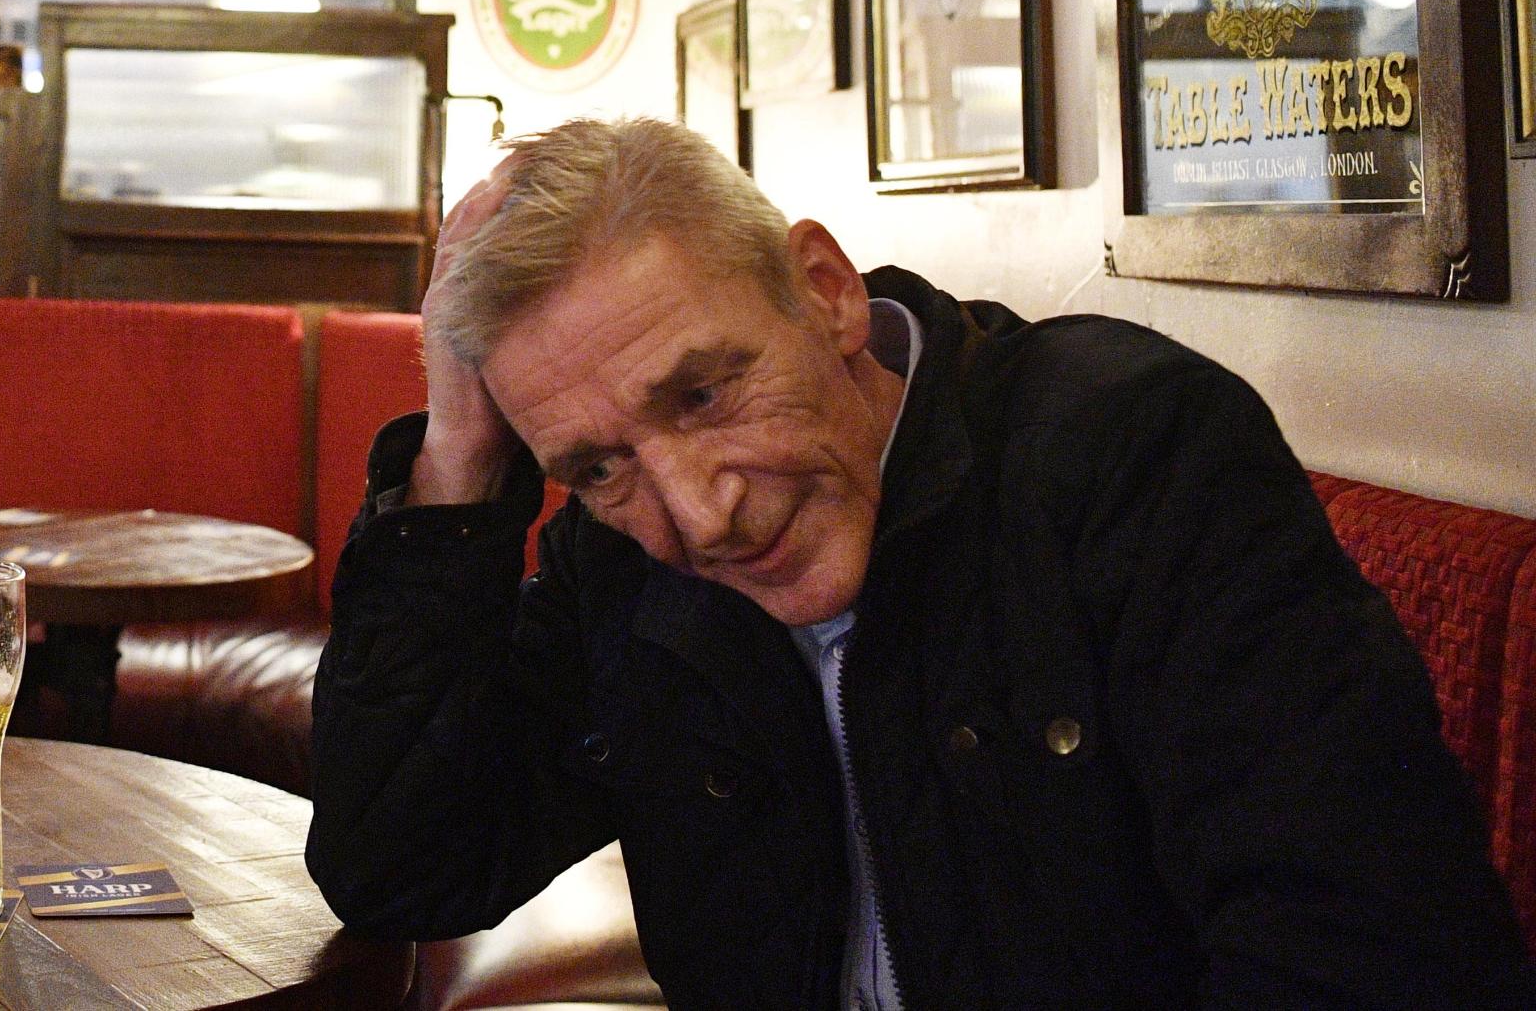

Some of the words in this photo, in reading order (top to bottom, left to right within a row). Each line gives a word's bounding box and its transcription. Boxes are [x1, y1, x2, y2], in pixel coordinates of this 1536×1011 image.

[1144, 76, 1252, 150] TABLE
[1255, 51, 1414, 140] WATERS
[50, 882, 154, 896] HARP
